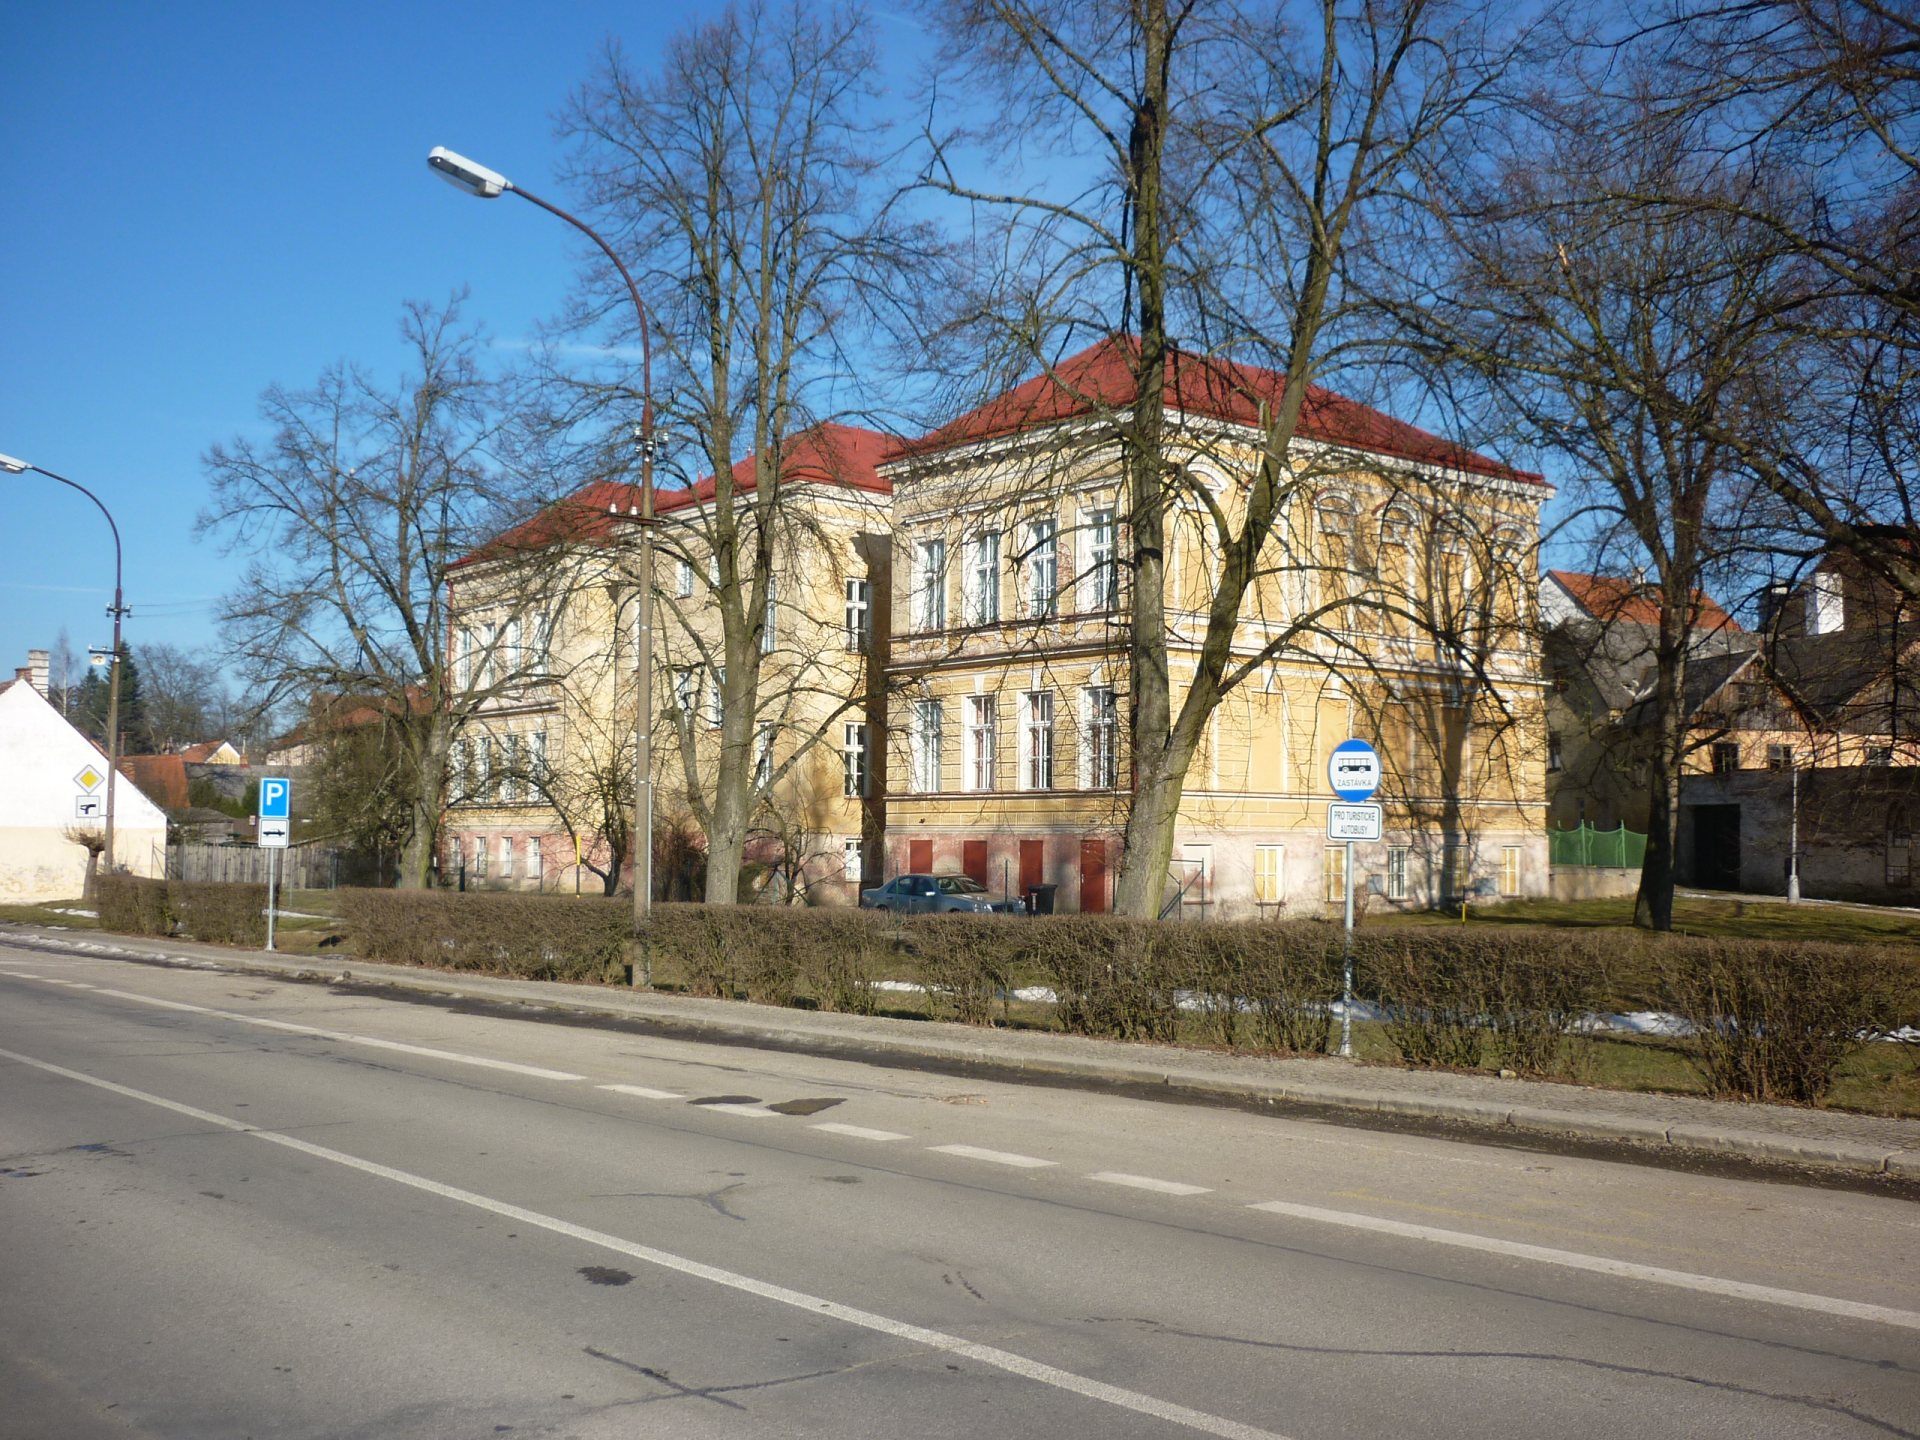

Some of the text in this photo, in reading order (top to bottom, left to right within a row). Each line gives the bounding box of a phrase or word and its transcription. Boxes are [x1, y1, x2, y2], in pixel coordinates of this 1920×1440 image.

[1337, 777, 1372, 787] ZASTÁVKA
[266, 783, 284, 806] P
[1334, 810, 1345, 820] PRO
[1340, 824, 1368, 835] AUTOBUSY
